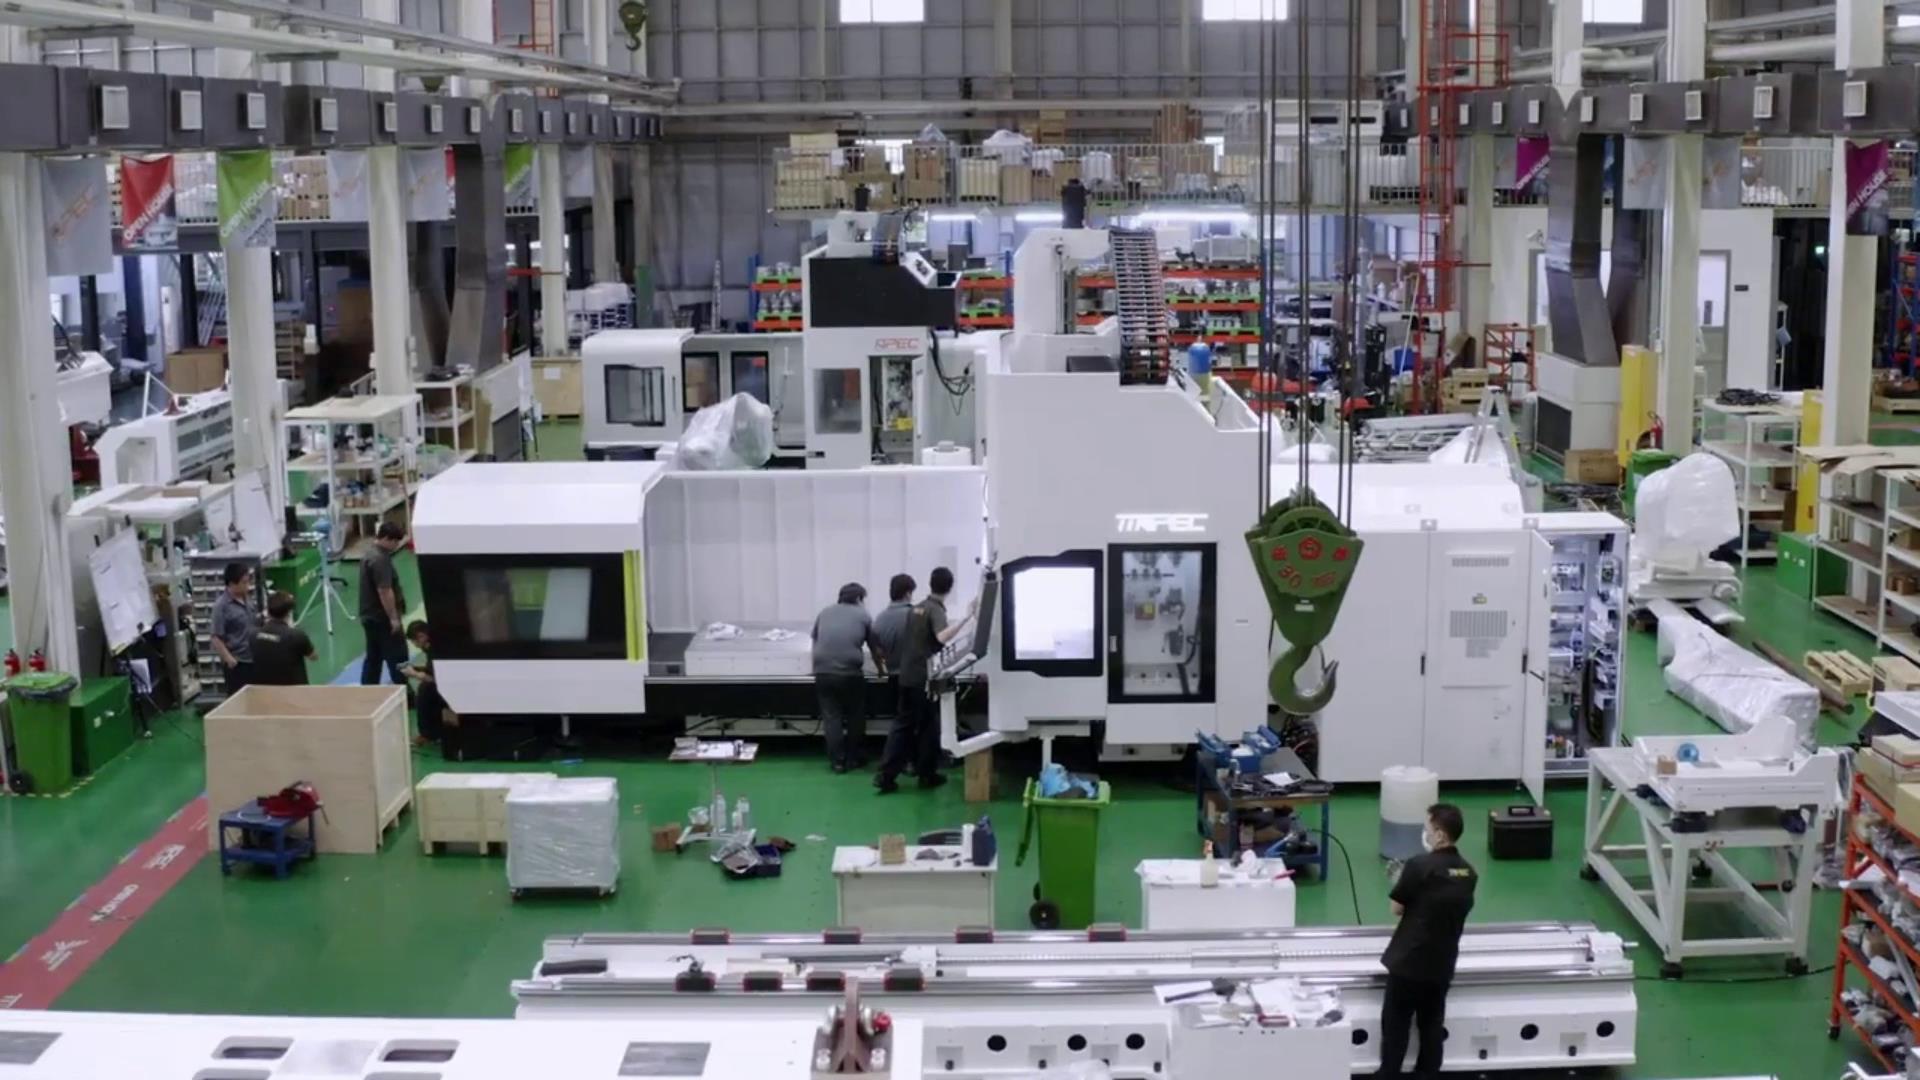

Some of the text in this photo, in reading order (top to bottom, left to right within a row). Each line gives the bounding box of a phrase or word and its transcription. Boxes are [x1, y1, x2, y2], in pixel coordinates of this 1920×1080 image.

[1856, 169, 1887, 203] HOUSE
[123, 183, 173, 241] OPEN HOUSE
